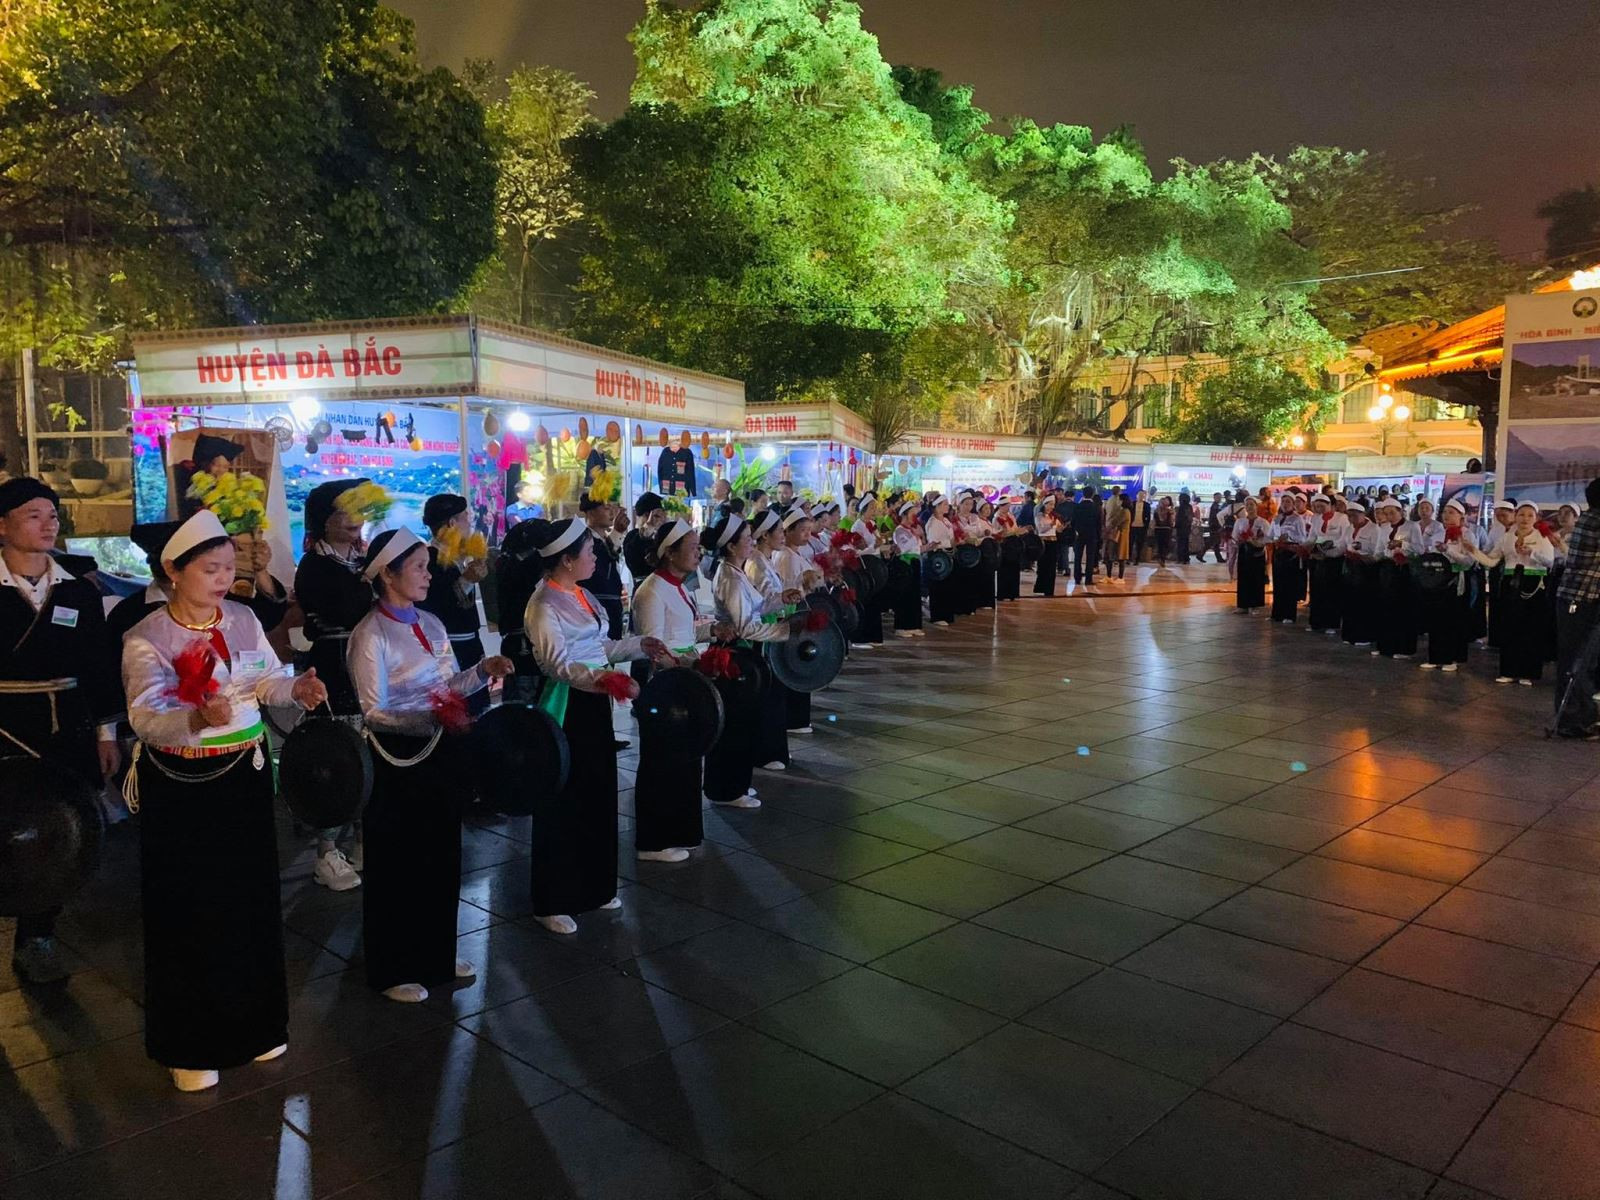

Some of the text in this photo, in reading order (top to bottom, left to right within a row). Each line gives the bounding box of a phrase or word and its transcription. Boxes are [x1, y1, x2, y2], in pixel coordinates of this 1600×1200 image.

[197, 336, 402, 387] HUYỆN ĐÀ BẮC
[595, 369, 686, 409] HUYỆN ĐÀ BẮC
